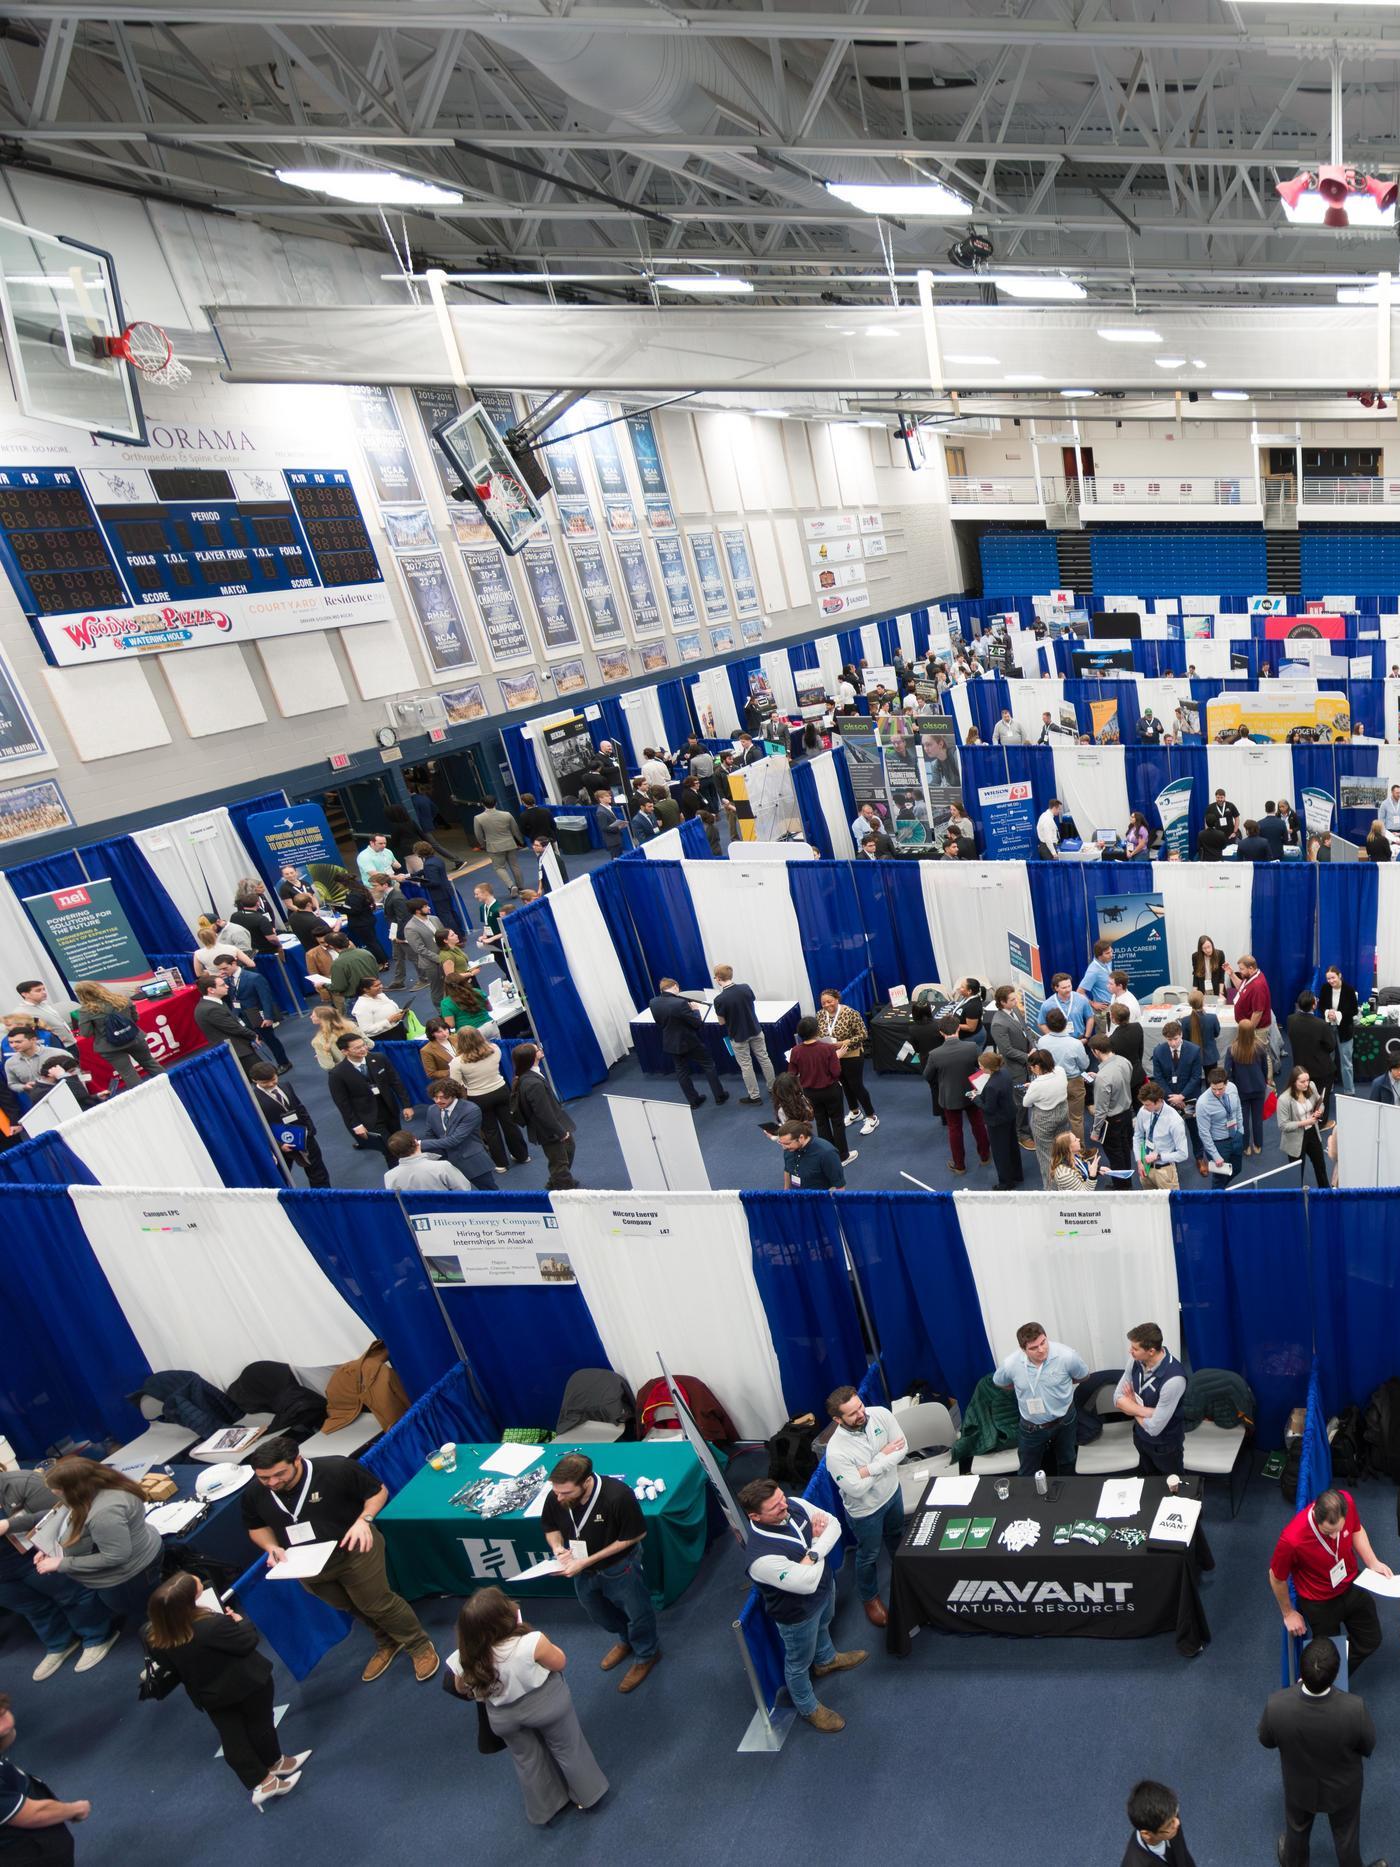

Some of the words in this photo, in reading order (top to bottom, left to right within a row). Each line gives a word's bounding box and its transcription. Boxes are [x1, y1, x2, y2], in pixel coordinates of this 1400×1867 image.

[122, 452, 178, 463] Orthopedics
[188, 453, 212, 463] Spine
[214, 454, 240, 463] Center
[22, 473, 38, 484] FLS
[54, 473, 70, 484] PTS
[191, 512, 220, 521] PERIOD
[127, 555, 156, 566] FOULS
[164, 553, 188, 564] T.O.L.
[196, 551, 225, 561] PLAYER
[227, 549, 247, 559] FOUL
[253, 548, 274, 558] T.O.L.
[279, 546, 302, 556] FOULS
[291, 578, 313, 588] SCORE
[220, 585, 248, 595] MATCH
[142, 592, 170, 603] SCORE
[324, 593, 373, 607] Residence
[249, 598, 316, 614] COURTYARD
[672, 604, 694, 616] FINALS
[161, 607, 232, 632] PIZZA
[128, 634, 165, 646] WATERING
[167, 631, 185, 642] HOLE
[843, 722, 868, 730] olsson
[923, 722, 948, 730] olsson
[15, 743, 37, 753] NATION
[984, 788, 1008, 797] WILSON
[47, 909, 90, 925] POWERING
[49, 915, 95, 931] SOLUTIONS
[97, 910, 112, 919] FOR
[52, 928, 68, 936] THE
[70, 919, 101, 933] FUTURE
[612, 1211, 635, 1219] Hilcorp
[636, 1211, 658, 1219] Energy
[433, 1218, 466, 1229] Hilcorp
[468, 1217, 500, 1227] Energy
[502, 1217, 541, 1227] Company
[622, 1218, 652, 1226] Company
[456, 1230, 480, 1238] Hiring
[453, 1238, 497, 1247] Internships
[507, 1237, 534, 1245] Alaska!
[1159, 1521, 1188, 1531] AVANT
[970, 1580, 1134, 1603] AVANT
[947, 1604, 1027, 1614] NATURAL
[1034, 1603, 1135, 1614] RESOURCES
